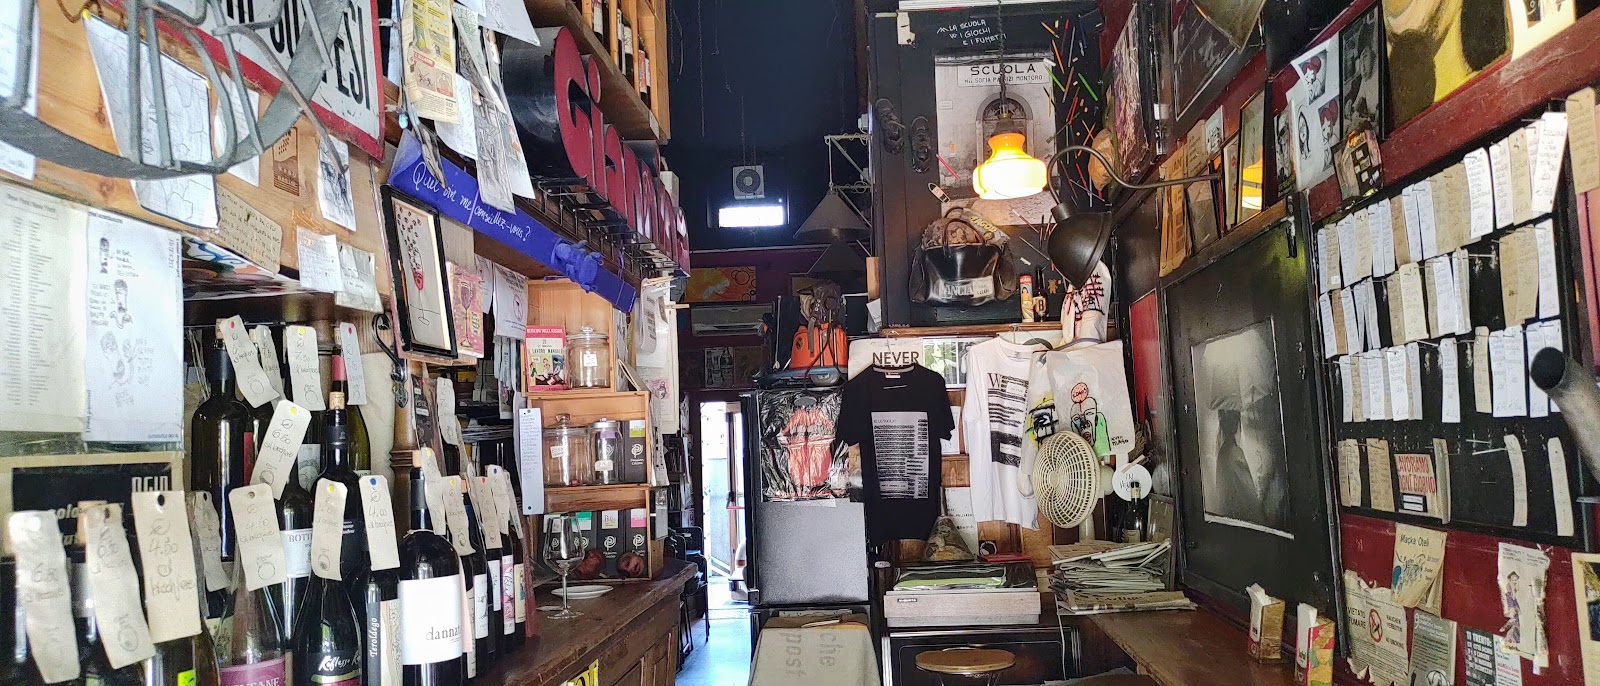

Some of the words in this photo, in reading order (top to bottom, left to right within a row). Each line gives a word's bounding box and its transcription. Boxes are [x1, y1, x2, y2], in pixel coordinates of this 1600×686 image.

[960, 19, 987, 30] SCUOLA
[964, 27, 991, 38] GIOCHI
[970, 63, 1036, 76] SCUOLA
[872, 351, 920, 365] NEVER
[368, 617, 380, 658] Teroldego
